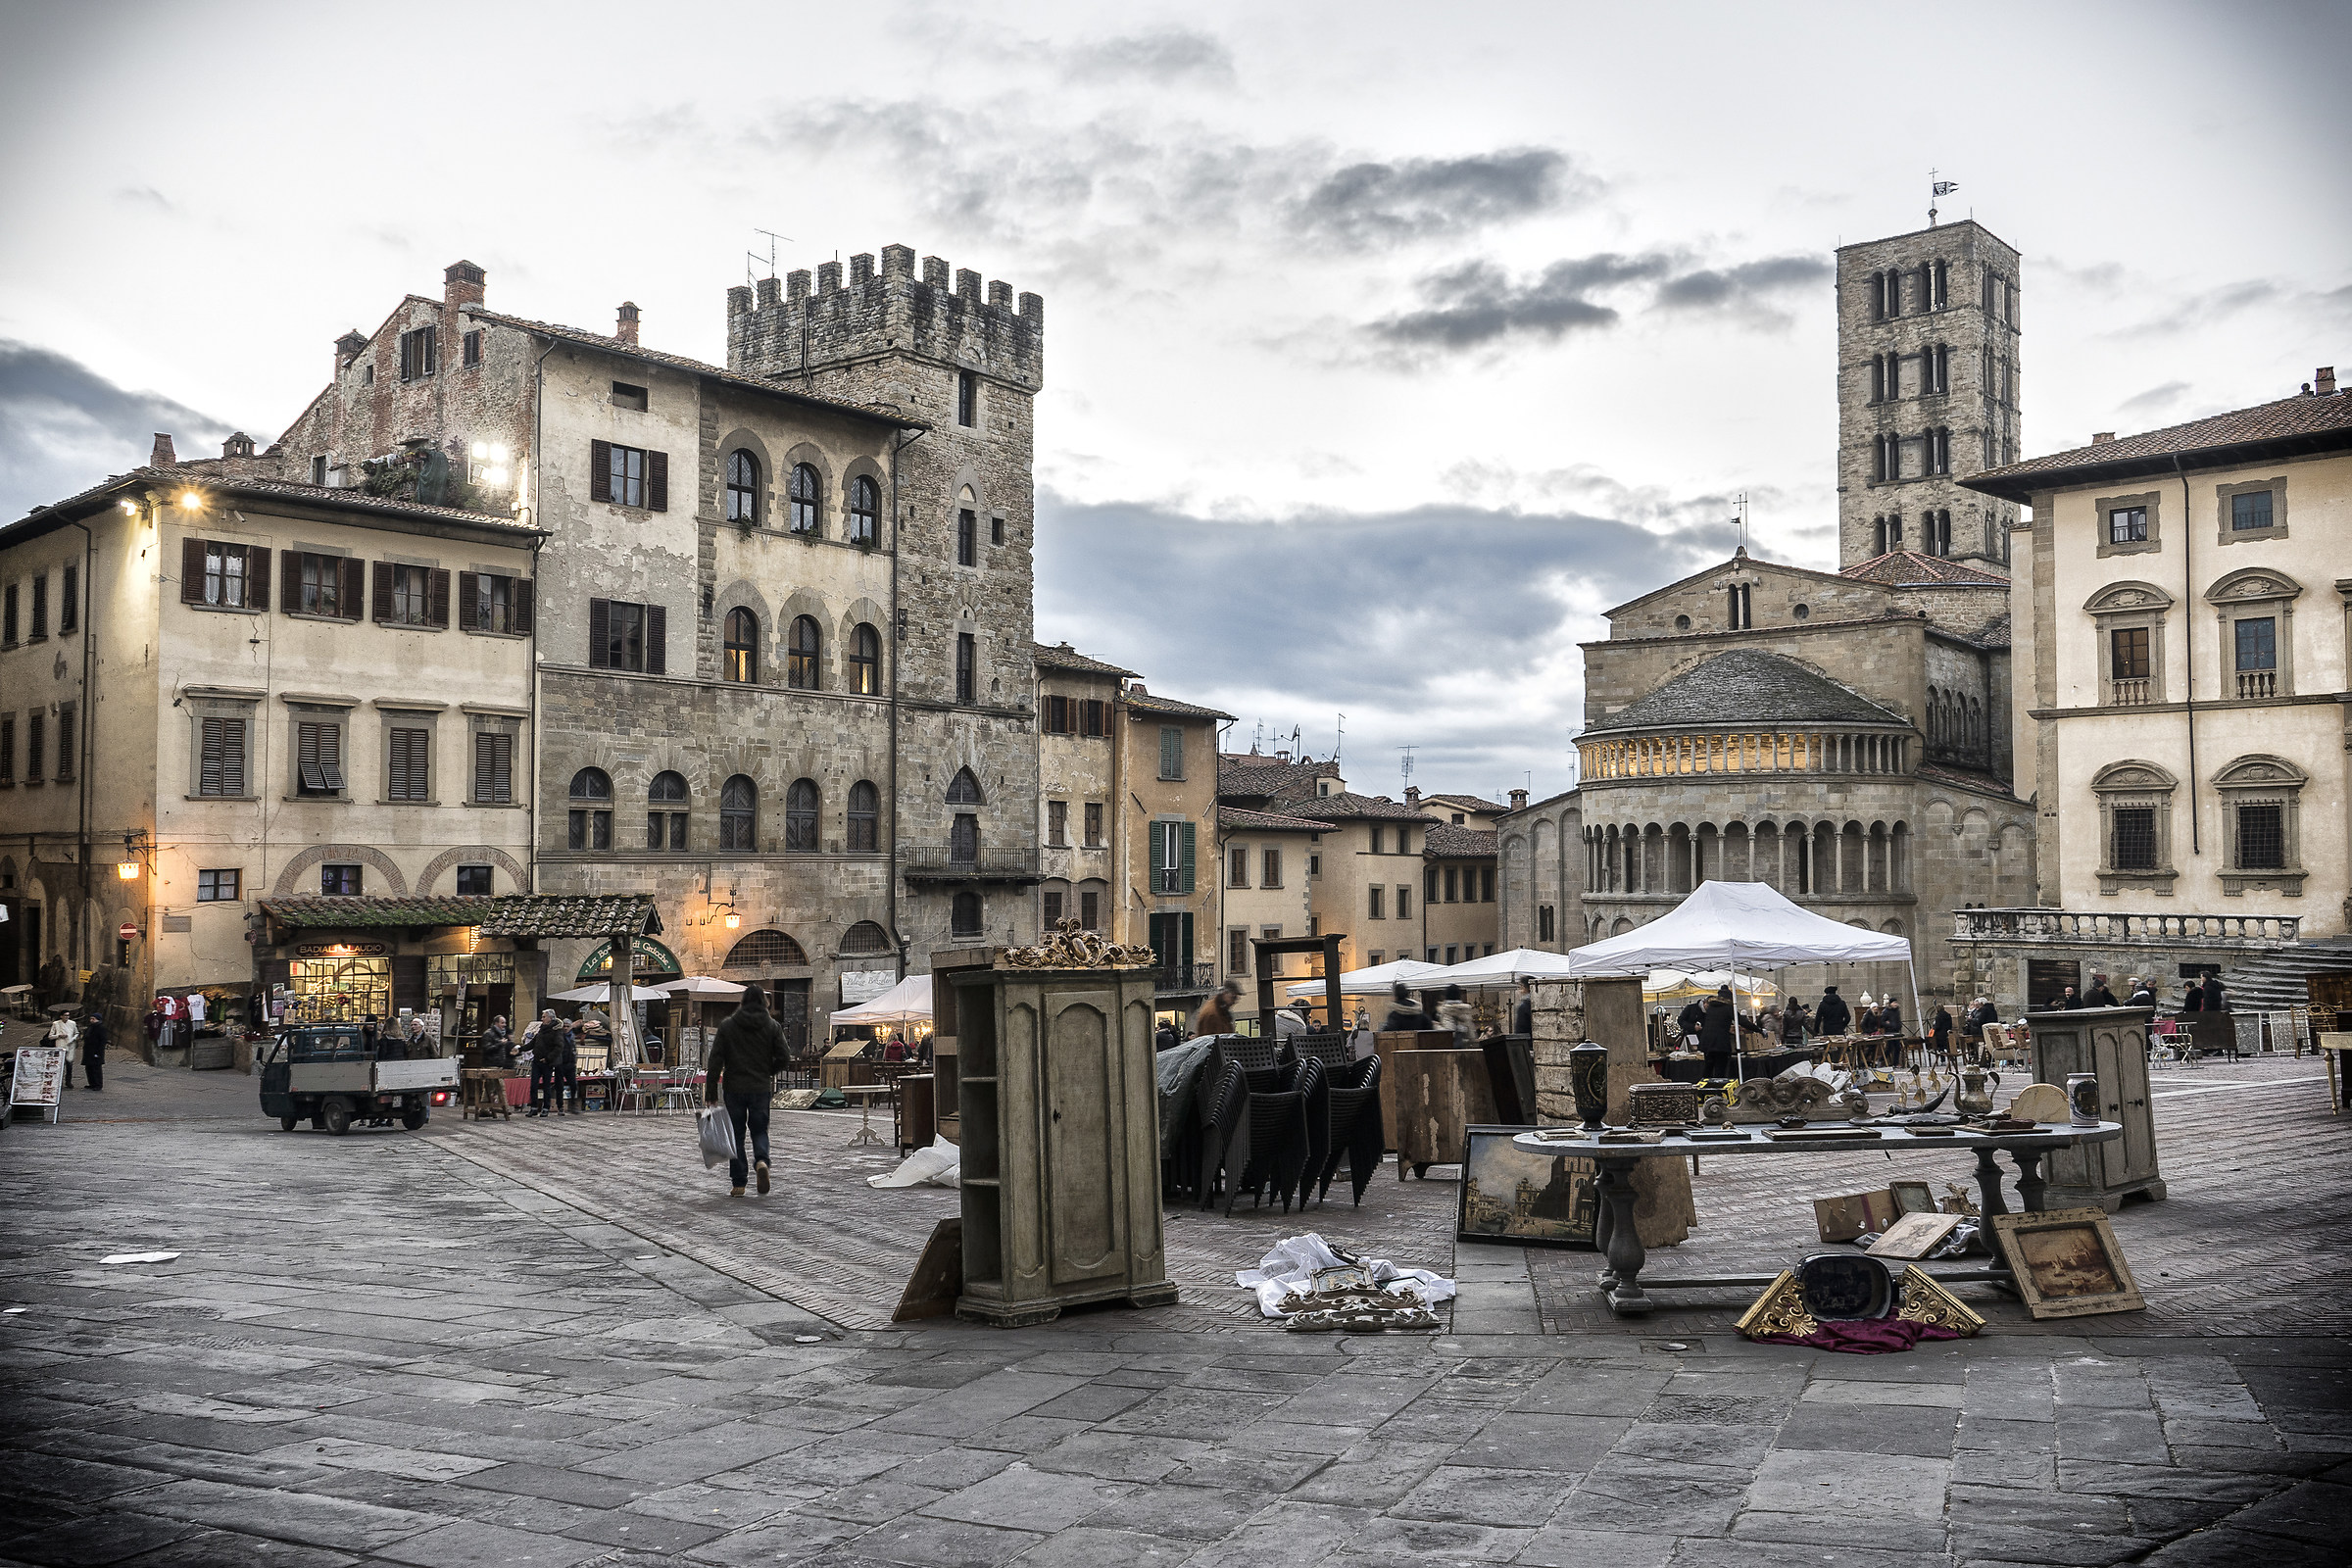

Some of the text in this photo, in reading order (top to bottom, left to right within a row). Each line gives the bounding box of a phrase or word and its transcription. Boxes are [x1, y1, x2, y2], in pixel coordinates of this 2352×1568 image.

[300, 945, 337, 954] BADIALI
[586, 957, 598, 969] La
[632, 940, 640, 949] di
